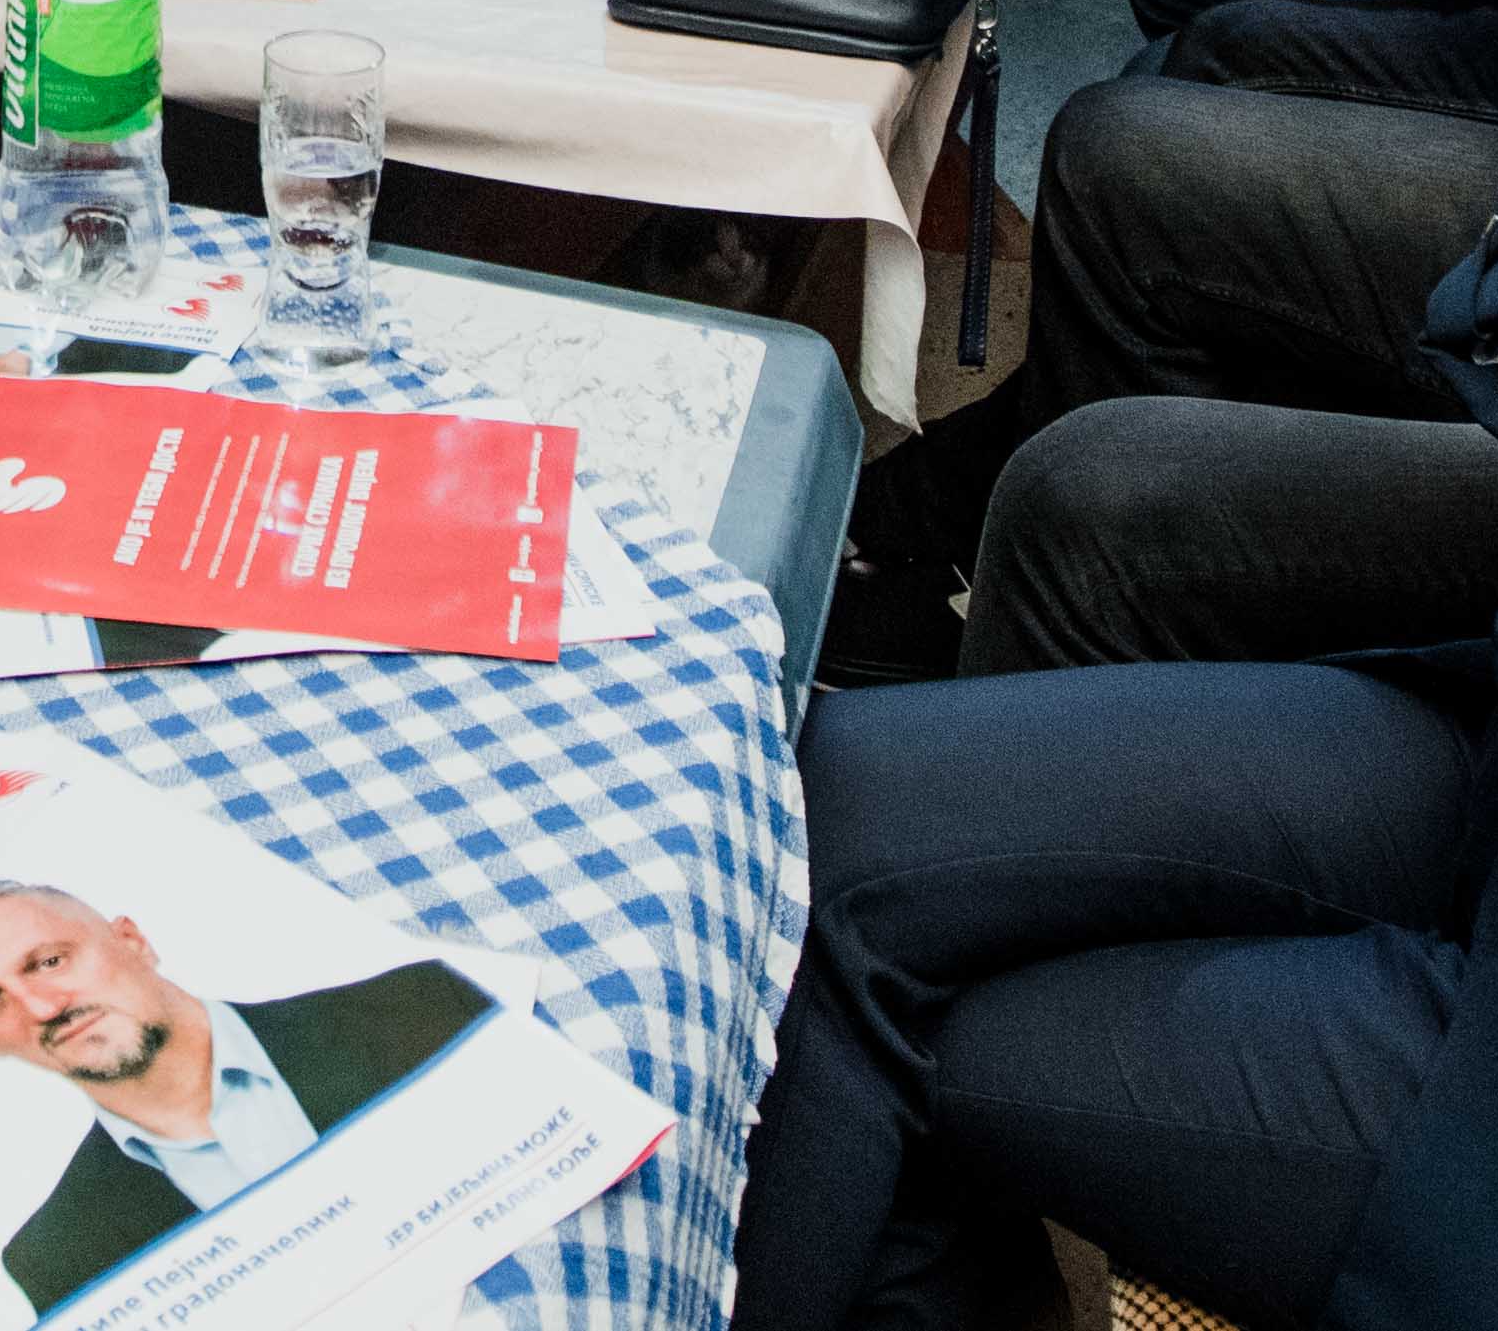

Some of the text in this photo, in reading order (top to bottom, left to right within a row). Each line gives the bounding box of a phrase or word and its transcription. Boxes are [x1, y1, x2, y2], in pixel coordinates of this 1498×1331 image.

[516, 1105, 575, 1156] МОЖЕ
[547, 1133, 599, 1179] БОЉЕ
[142, 1236, 237, 1296] Пејчић
